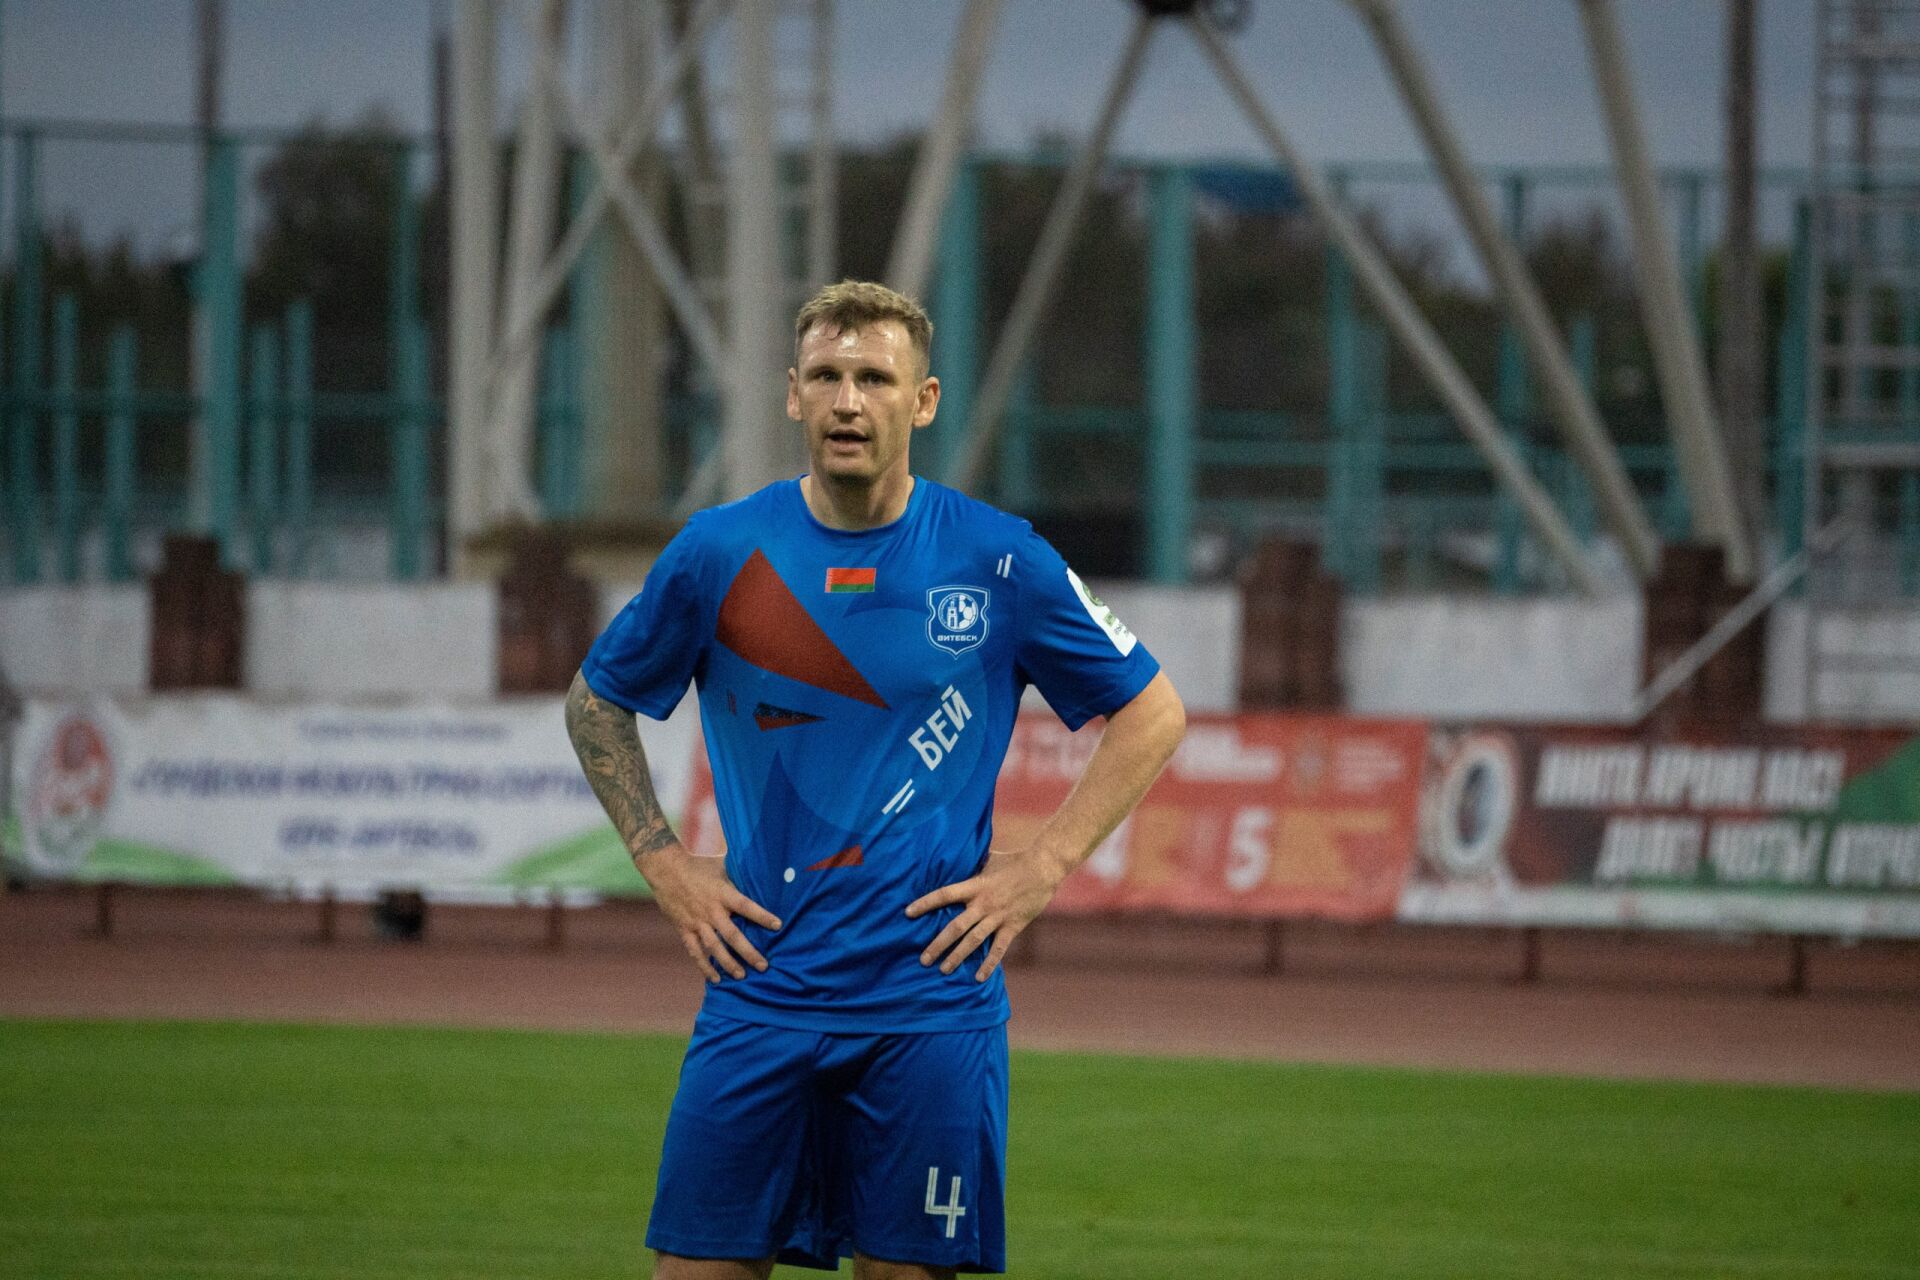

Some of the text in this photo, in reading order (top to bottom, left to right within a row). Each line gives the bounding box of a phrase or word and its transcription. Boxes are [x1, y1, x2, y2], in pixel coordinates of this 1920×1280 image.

[937, 634, 978, 642] ВИТЕБСК
[908, 685, 973, 771] БЕЙ
[1226, 806, 1274, 891] 5
[924, 1166, 966, 1239] 4
